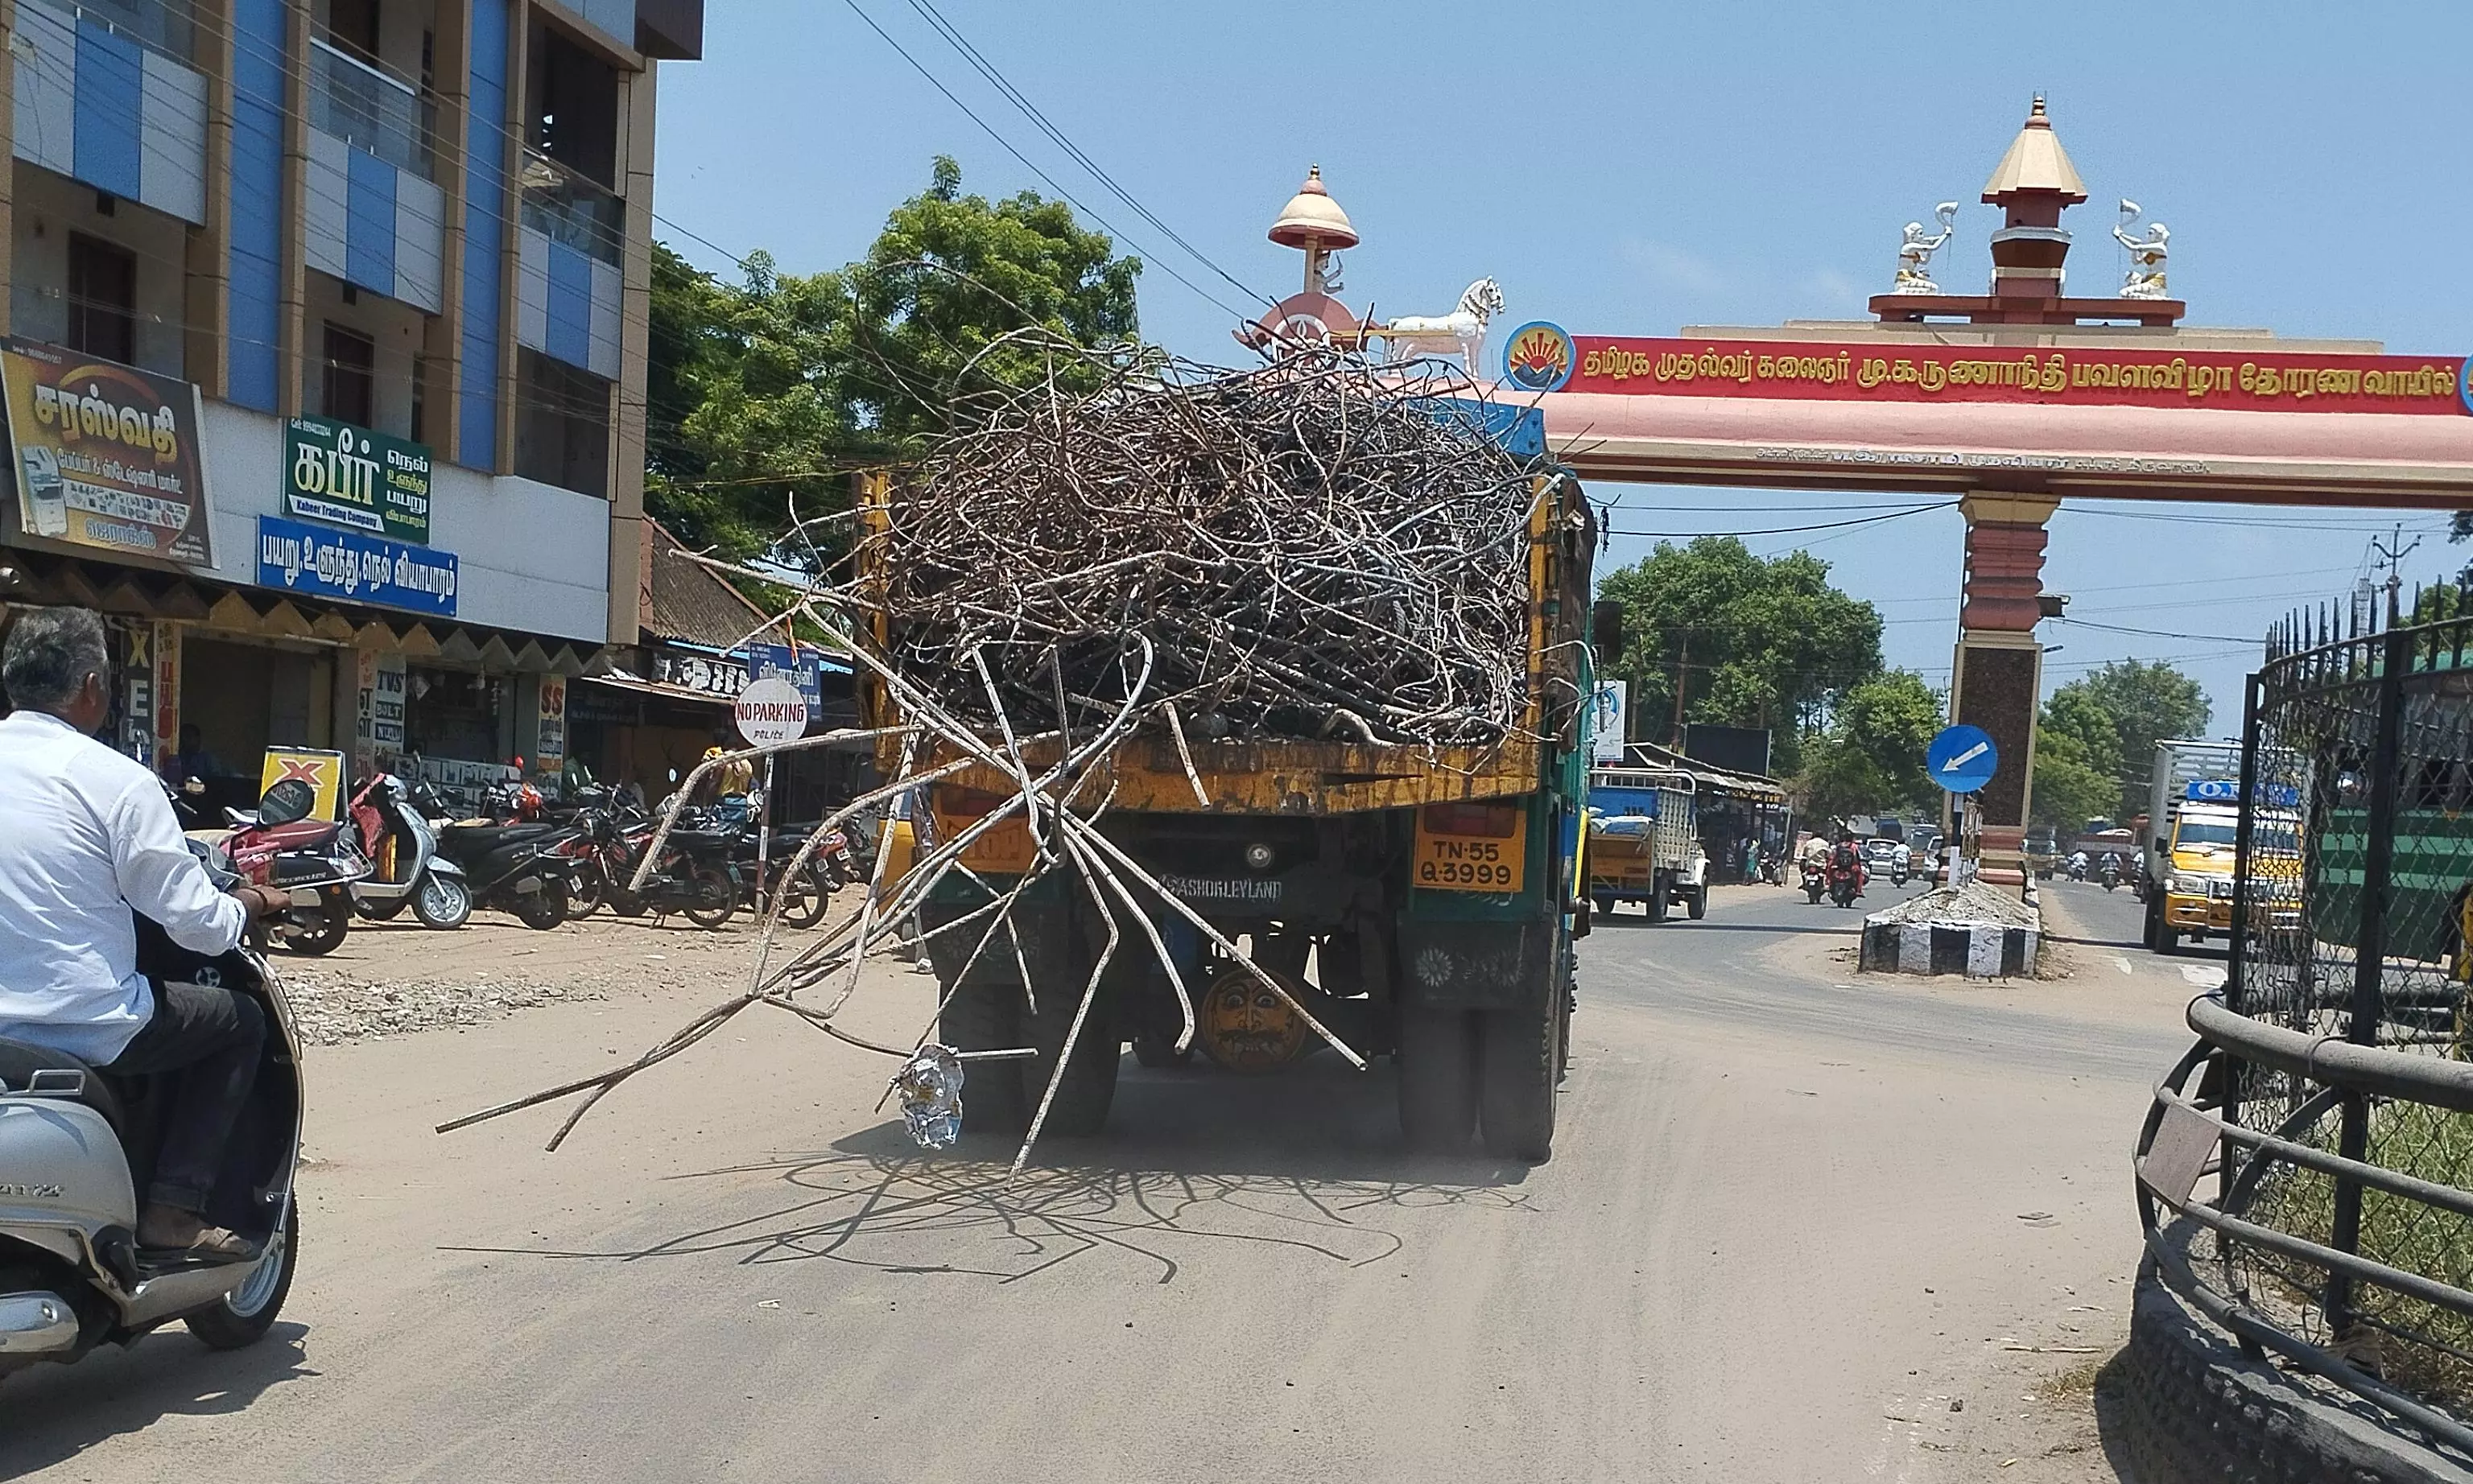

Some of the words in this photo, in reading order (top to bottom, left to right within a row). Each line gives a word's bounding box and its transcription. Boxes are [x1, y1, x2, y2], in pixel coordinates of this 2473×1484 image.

[1583, 345, 1649, 380] தமிழக
[1655, 347, 1753, 383] முதல்வர்
[1757, 351, 1850, 385] கலைஞர்
[1856, 354, 2066, 393] மு.கருணாநிதி
[2073, 357, 2232, 398] பவளவிழா
[2240, 362, 2361, 398] தோரண
[2364, 365, 2458, 398] வாயில்
[34, 383, 179, 464] சரஸ்வதி
[295, 427, 380, 505] கபீர்
[386, 449, 428, 473] நெல்
[386, 469, 427, 496] உளுந்து
[296, 499, 321, 514] Kabeer
[321, 505, 346, 521] Trading
[347, 510, 378, 528] Company
[386, 489, 427, 515] பயறு
[394, 551, 456, 604] வியாபாரம்
[377, 670, 404, 694] TVS
[376, 703, 403, 718] BOLT
[753, 729, 785, 740] POLICE
